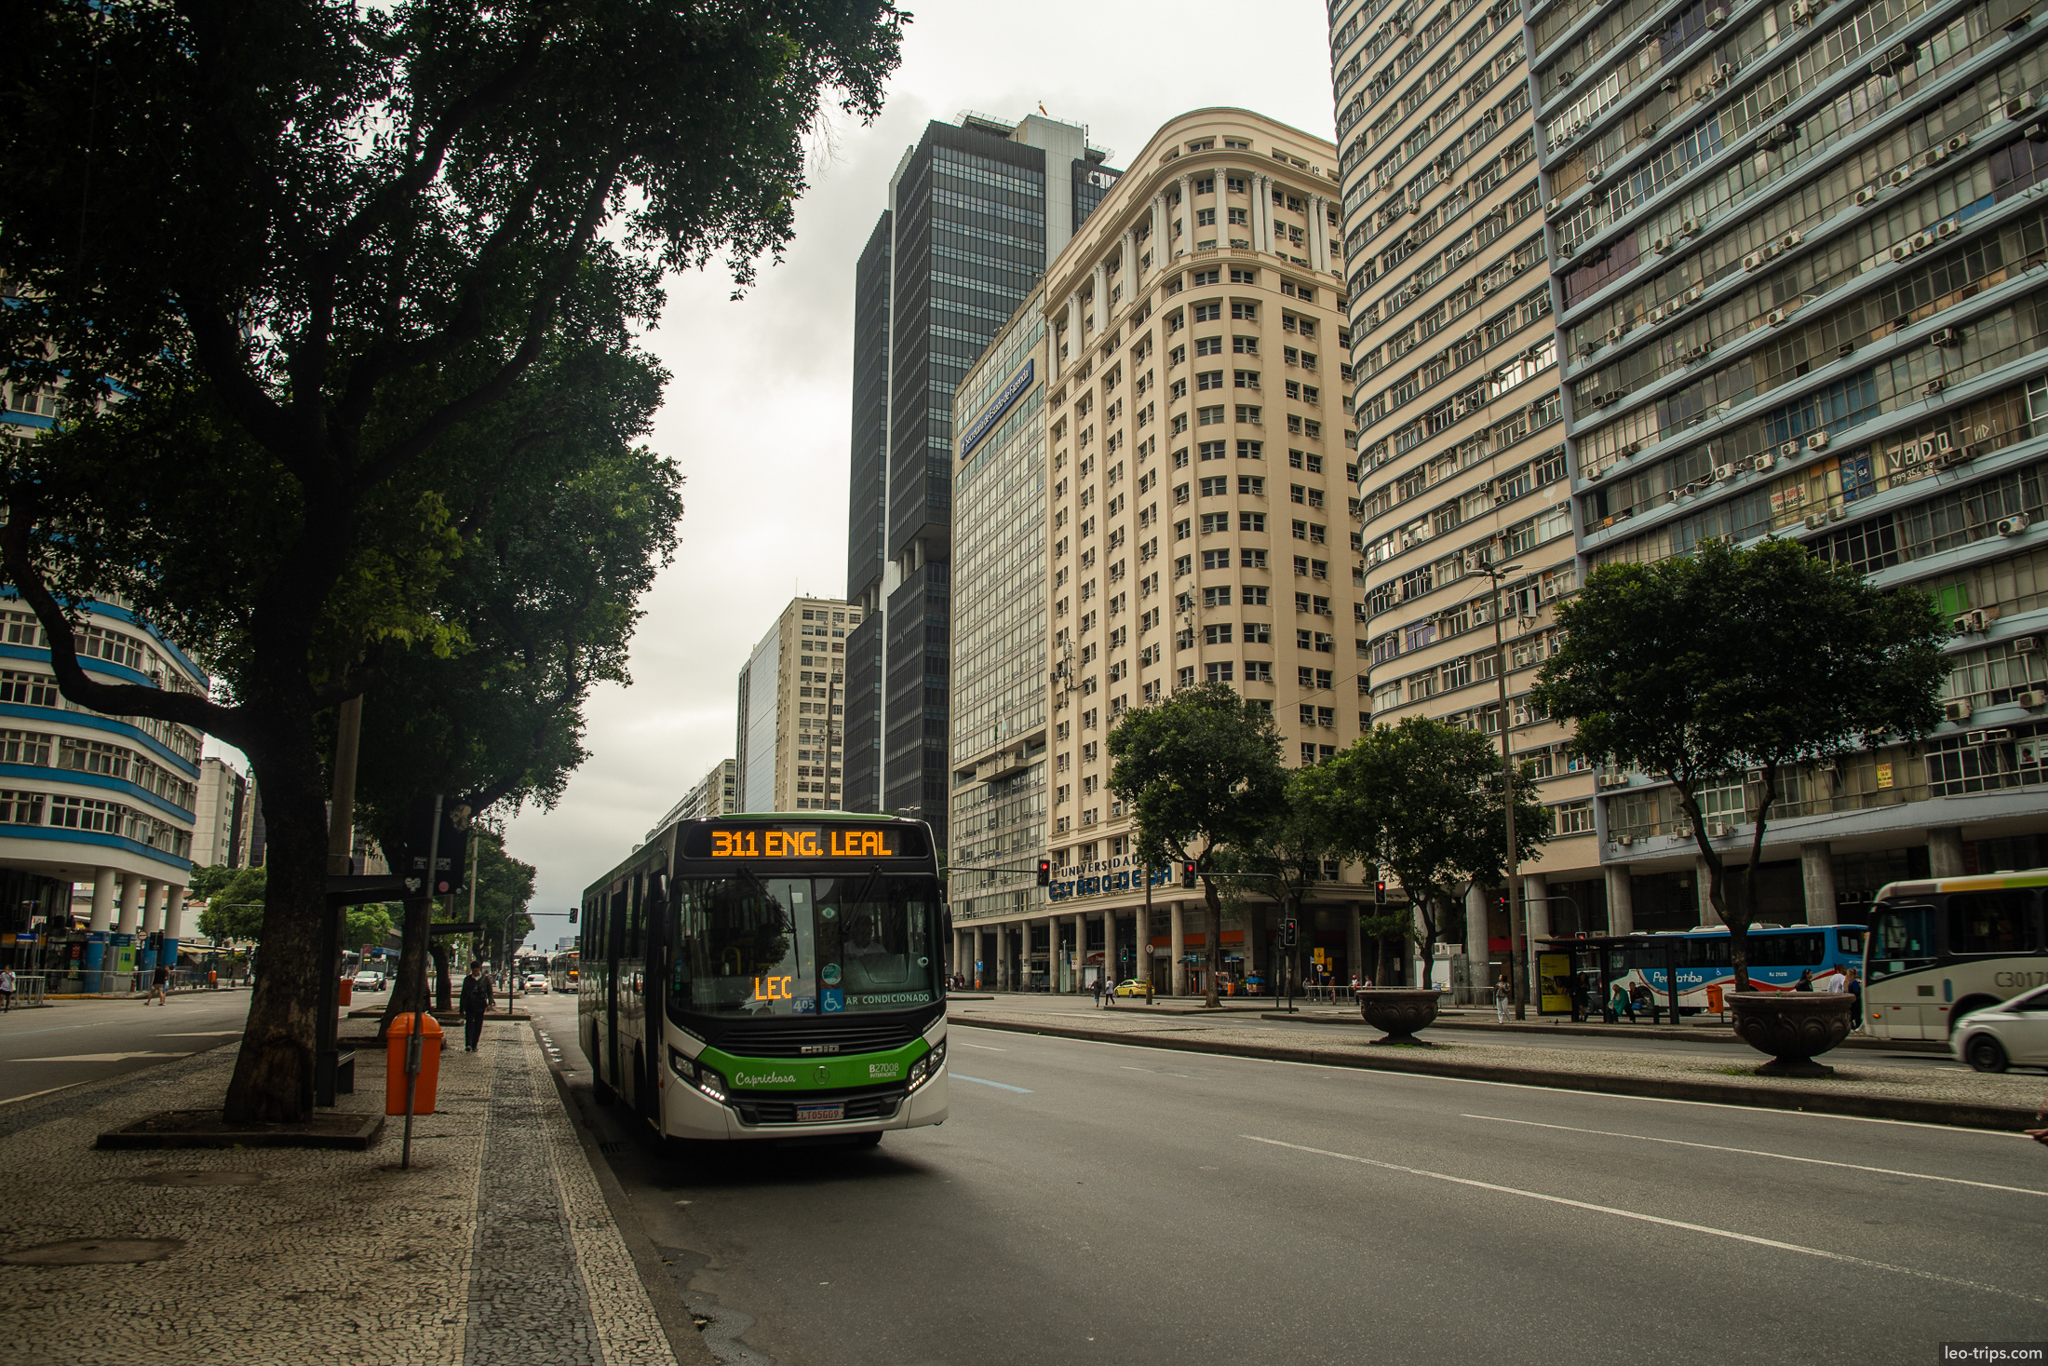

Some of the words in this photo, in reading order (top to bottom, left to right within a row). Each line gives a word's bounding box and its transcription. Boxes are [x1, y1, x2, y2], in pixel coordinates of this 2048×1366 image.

[1890, 432, 1949, 467] VENDO
[712, 831, 759, 857] 311
[765, 831, 824, 857] ENG.
[831, 831, 892, 856] LEAL
[1061, 853, 1140, 878] UNIVERSIDAD
[1118, 869, 1142, 890] DE
[755, 976, 791, 1000] LEC
[793, 1000, 815, 1013] 4,05
[846, 997, 858, 1005] AR
[862, 994, 930, 1004] CONDICIONADO
[869, 1063, 899, 1073] B27008
[735, 1071, 797, 1087] Caprichosa
